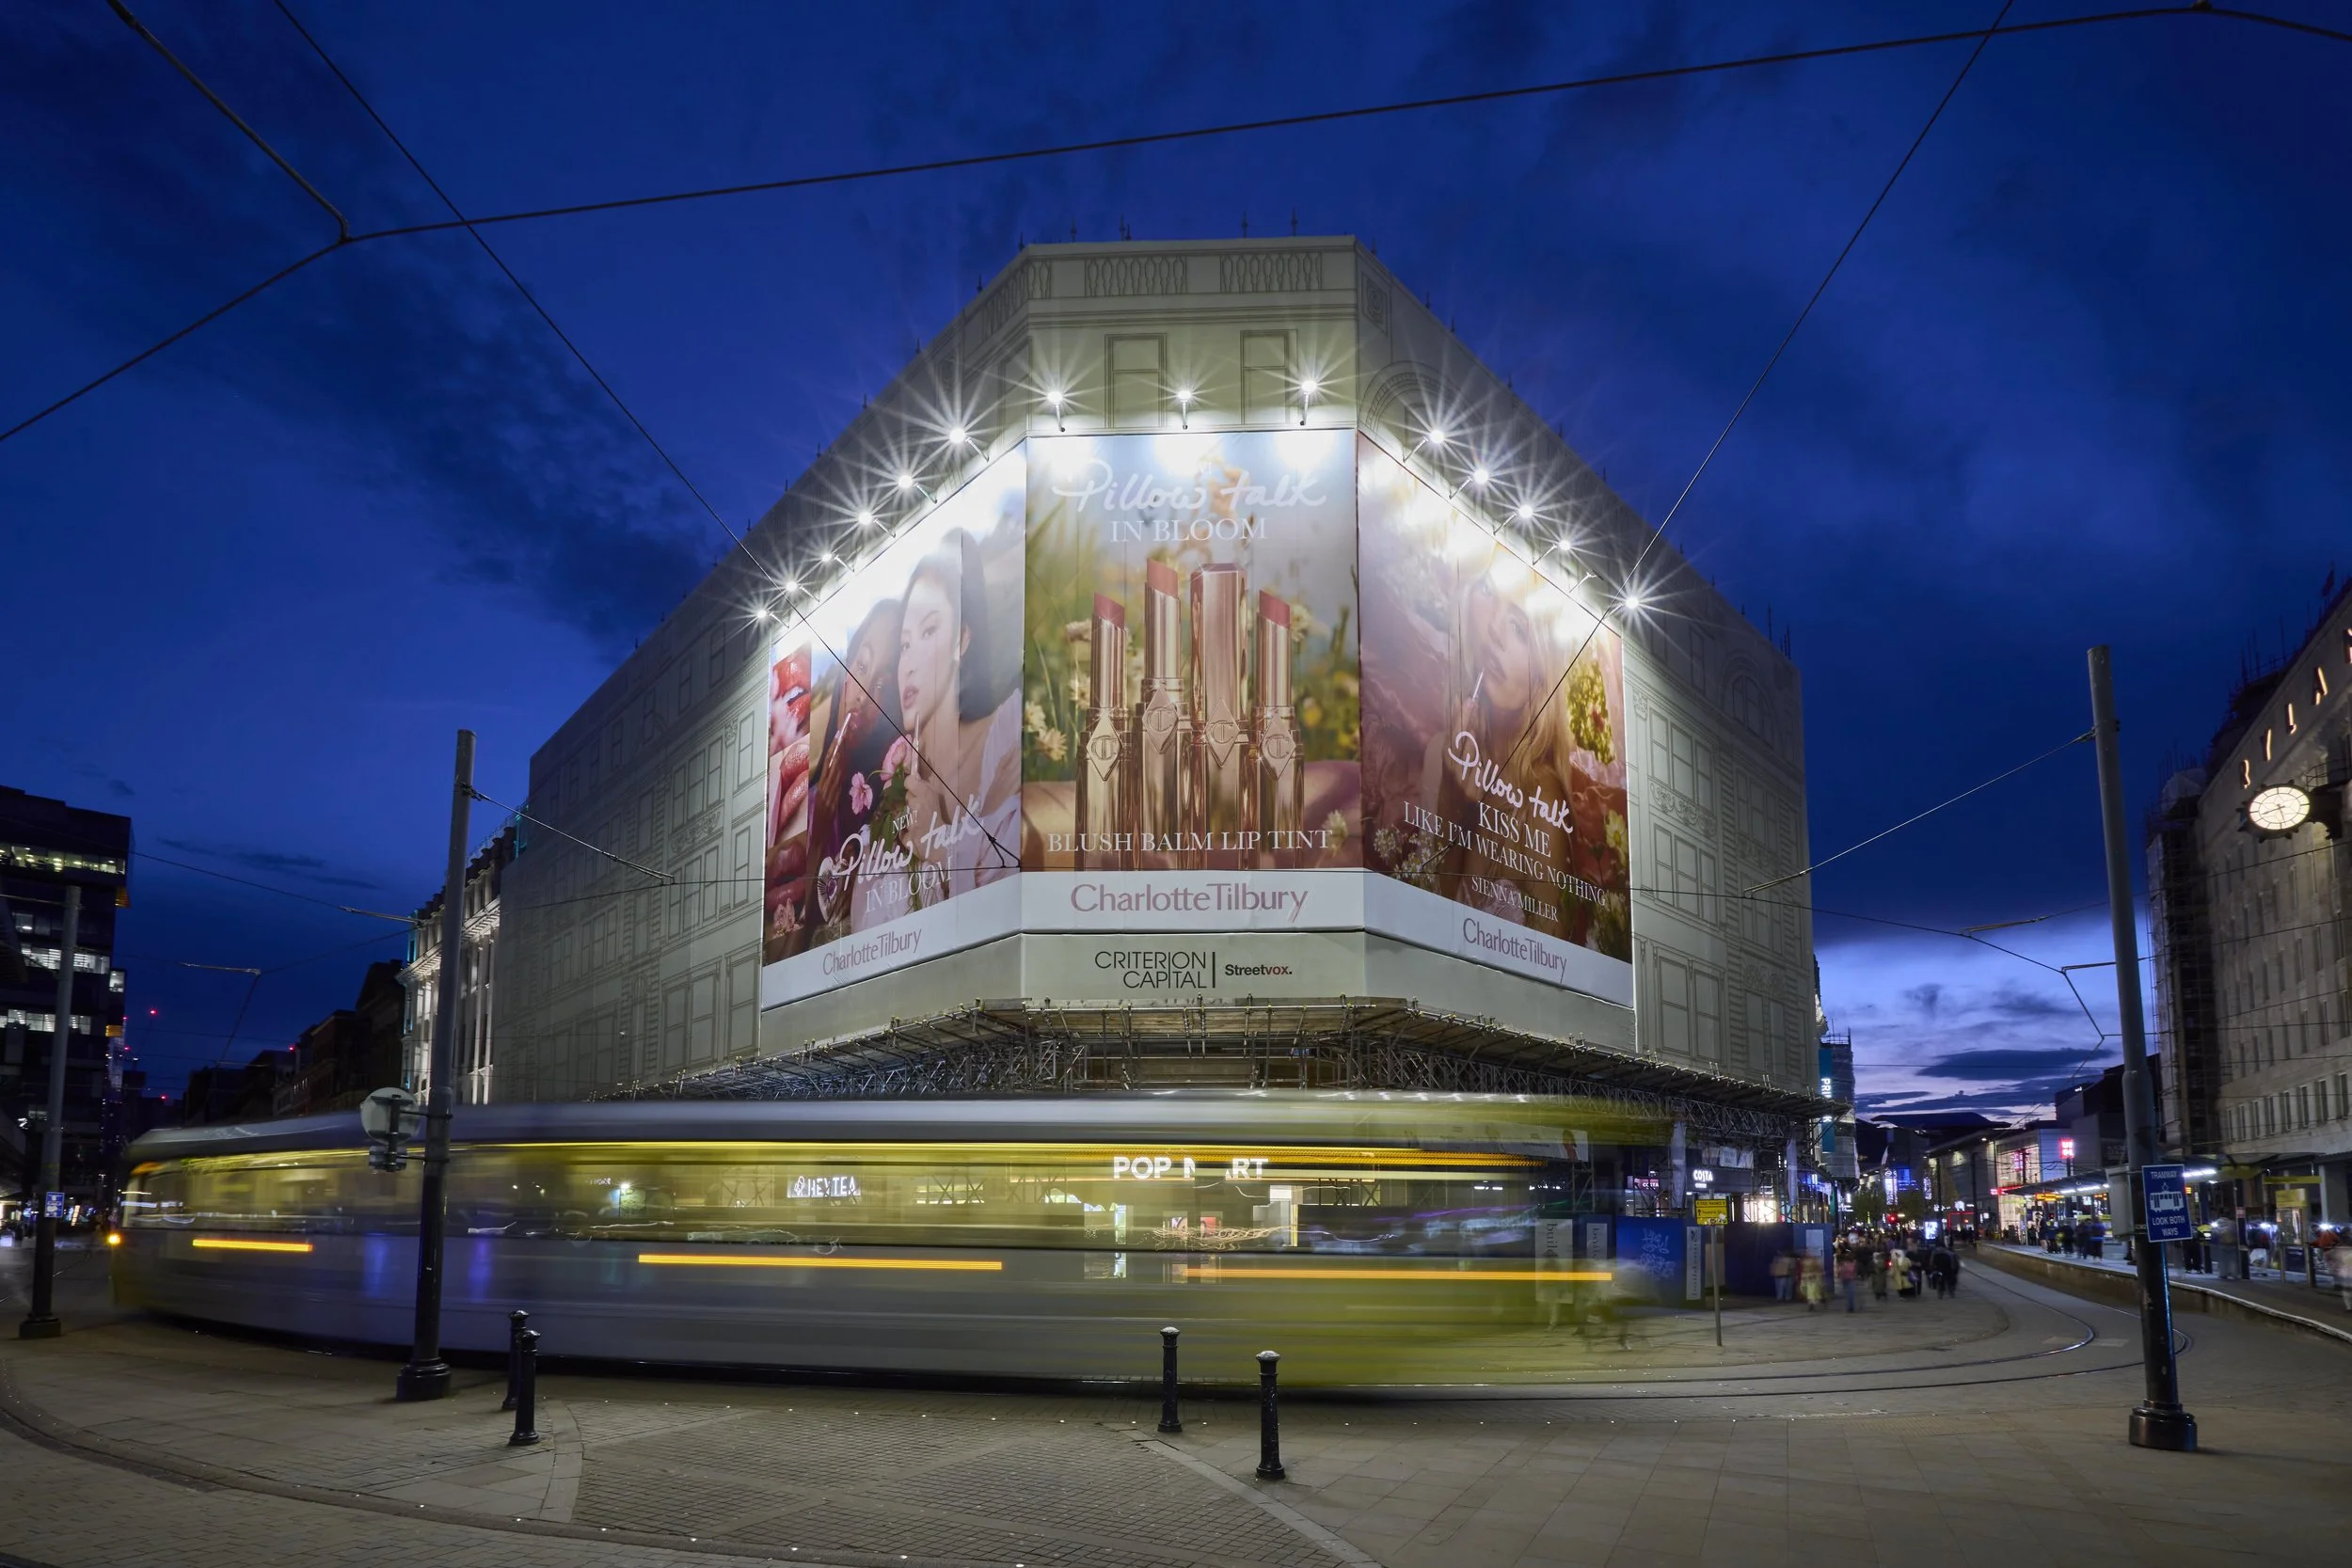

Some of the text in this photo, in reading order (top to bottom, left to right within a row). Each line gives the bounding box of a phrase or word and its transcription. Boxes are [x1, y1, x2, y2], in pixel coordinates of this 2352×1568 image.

[1052, 458, 1327, 512] Pillow talk
[1110, 517, 1267, 543] IN BLOOM
[1447, 730, 1573, 833] Pillow talk
[891, 810, 918, 834] NEW!
[1477, 800, 1551, 858] KISS ME
[833, 794, 984, 892] Pillow talk
[1047, 830, 1332, 853] BLUSH BALM LIP TINT
[1403, 801, 1606, 906] LIKE I'M WEARING NOTHING
[864, 856, 953, 914] IN BLOOM
[1470, 875, 1559, 923] SIENNA MILLER
[1094, 950, 1206, 970] CRITERION
[1224, 963, 1293, 977] Streetvox.
[1122, 970, 1207, 989] CAPITAL
[1821, 1078, 1833, 1122] PRIK
[1113, 1156, 1268, 1180] POP RT
[1693, 1169, 1713, 1181] COSTA
[2151, 1170, 2177, 1179] TRAMWAY
[2152, 1215, 2185, 1226] LOOK BOTH
[2162, 1227, 2178, 1236] WAYS
